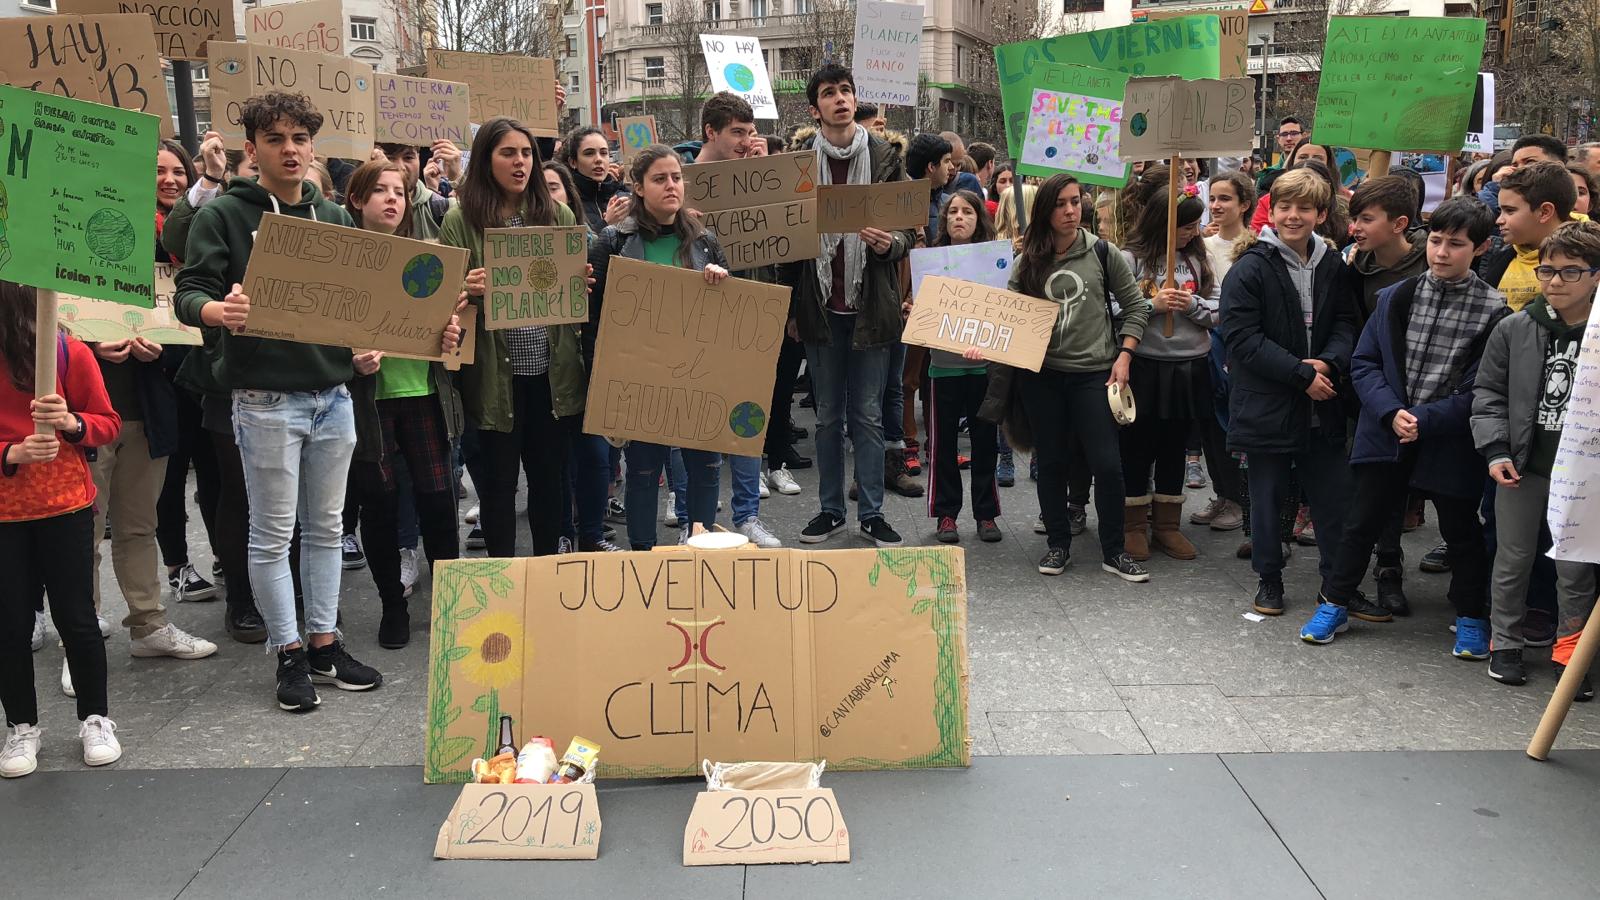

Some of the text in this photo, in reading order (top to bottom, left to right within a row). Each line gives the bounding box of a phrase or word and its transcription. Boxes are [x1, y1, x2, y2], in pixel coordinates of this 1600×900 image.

[254, 10, 284, 33] NO
[860, 24, 919, 44] PLANETA
[24, 22, 110, 72] HAY
[705, 40, 755, 54] NO HAY
[997, 17, 1219, 86] LOS VIERNES
[256, 55, 351, 94] NO LO
[865, 59, 904, 72] BANCO
[379, 79, 453, 96] LA TIERRA
[380, 95, 452, 112] ES LO QUE
[858, 85, 910, 103] RESCATADO
[328, 109, 367, 135] VER
[378, 111, 445, 122] TENEMOS EN
[1032, 92, 1121, 122] SAVE THE
[1222, 82, 1247, 134] B
[390, 121, 462, 142] COMÚN
[692, 168, 782, 201] SE NOS
[704, 203, 810, 237] ACABA EL
[263, 222, 393, 272] NUESTRO
[487, 232, 583, 259] THERE IS
[724, 236, 791, 263] TIEMPO
[492, 265, 523, 288] NO
[250, 276, 373, 323] NUESTRO
[569, 275, 587, 318] B
[939, 282, 1033, 314] NO ESTÁIS
[365, 309, 443, 344] futuro
[610, 274, 783, 353] SALVEMOS
[937, 312, 1014, 353] NADA
[667, 348, 711, 380] el
[556, 557, 840, 614] JUVENTUD
[604, 680, 779, 741] CLIMA
[820, 651, 901, 738] @CANTABRIAXCLIMA
[467, 790, 585, 847] 2019
[715, 795, 835, 851] 2050
